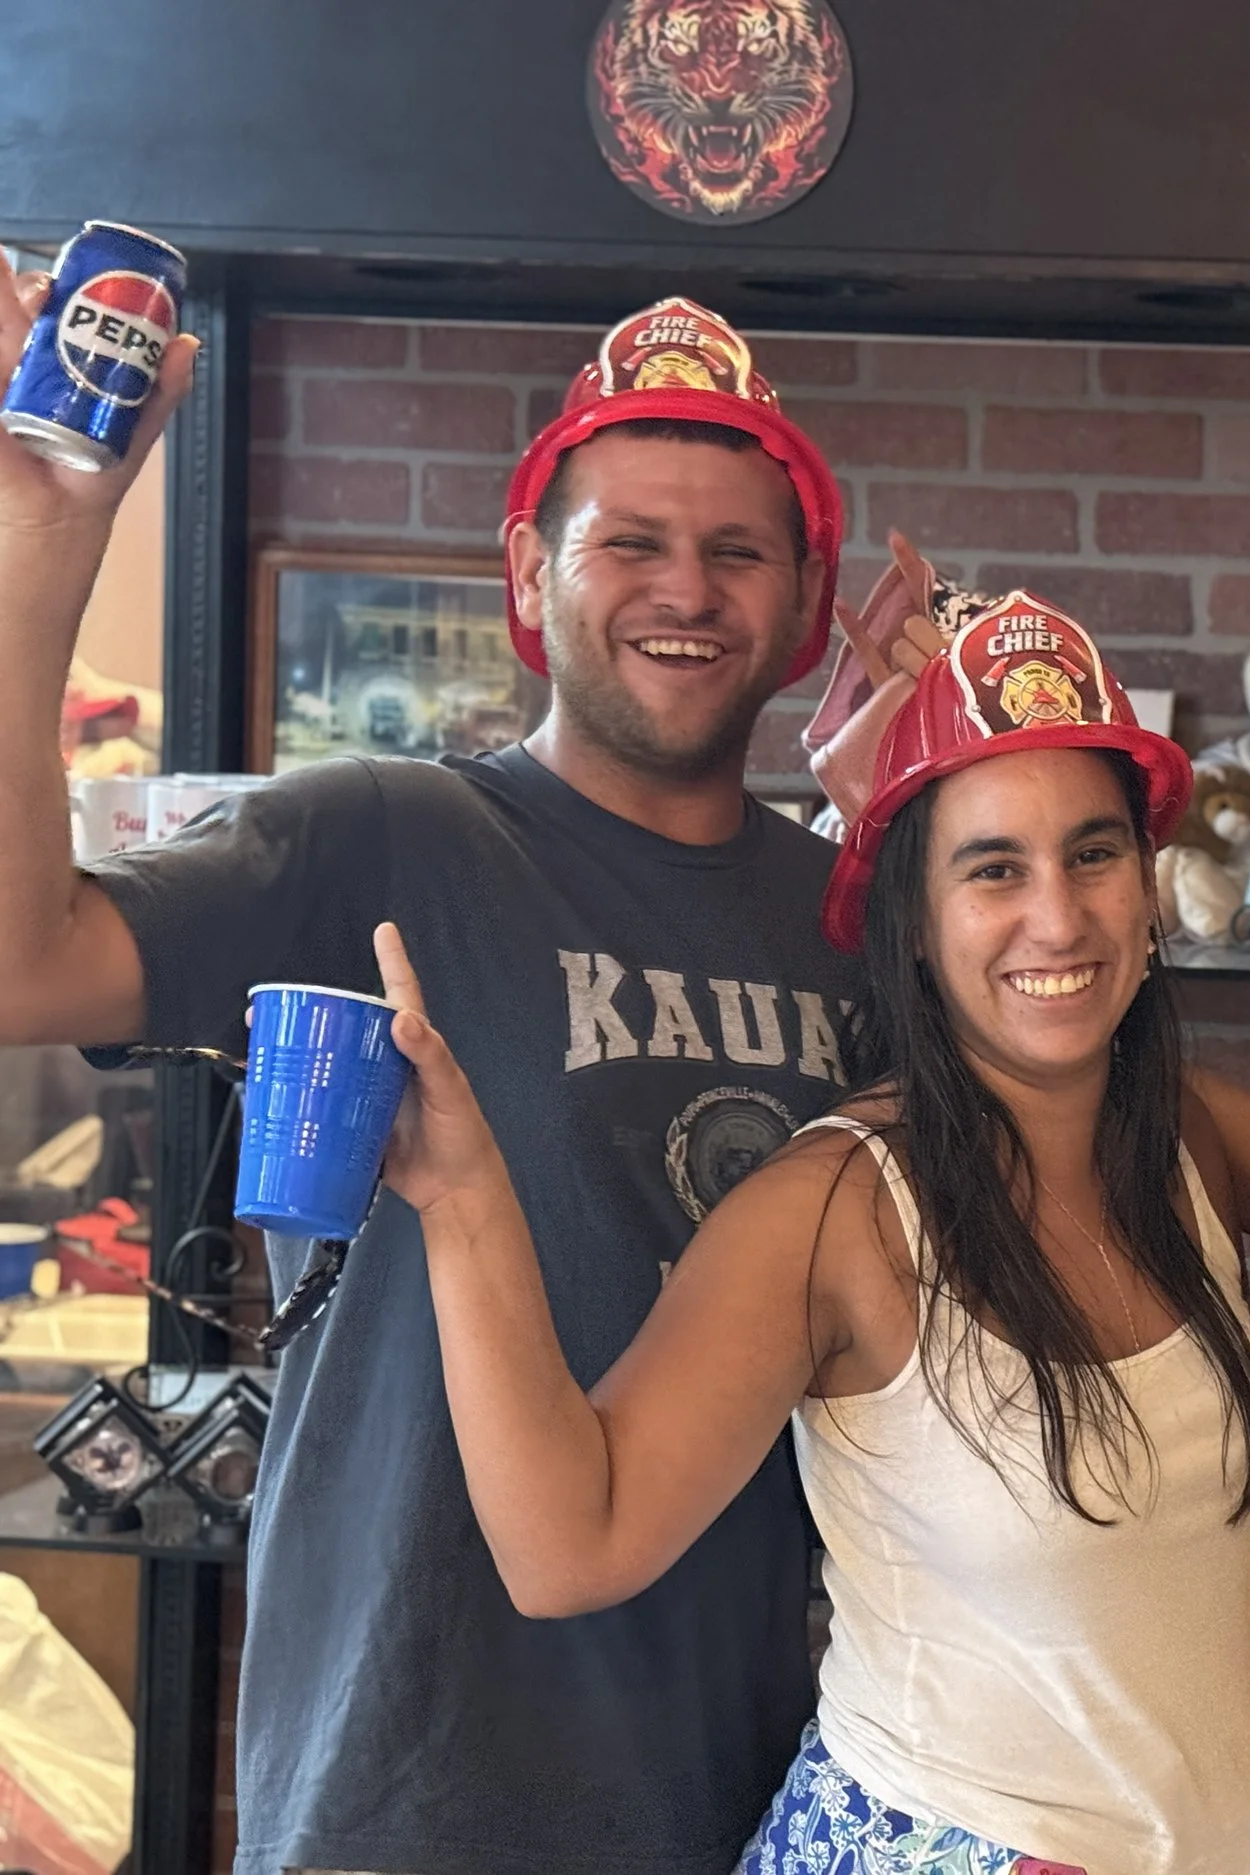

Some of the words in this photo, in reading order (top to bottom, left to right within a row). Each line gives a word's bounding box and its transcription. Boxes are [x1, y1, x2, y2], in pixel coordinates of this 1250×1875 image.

[650, 316, 699, 330] FIRE
[68, 304, 161, 366] PEPS
[634, 328, 715, 348] CHIEF
[999, 615, 1048, 632] FIRE
[987, 631, 1064, 656] CHIEF
